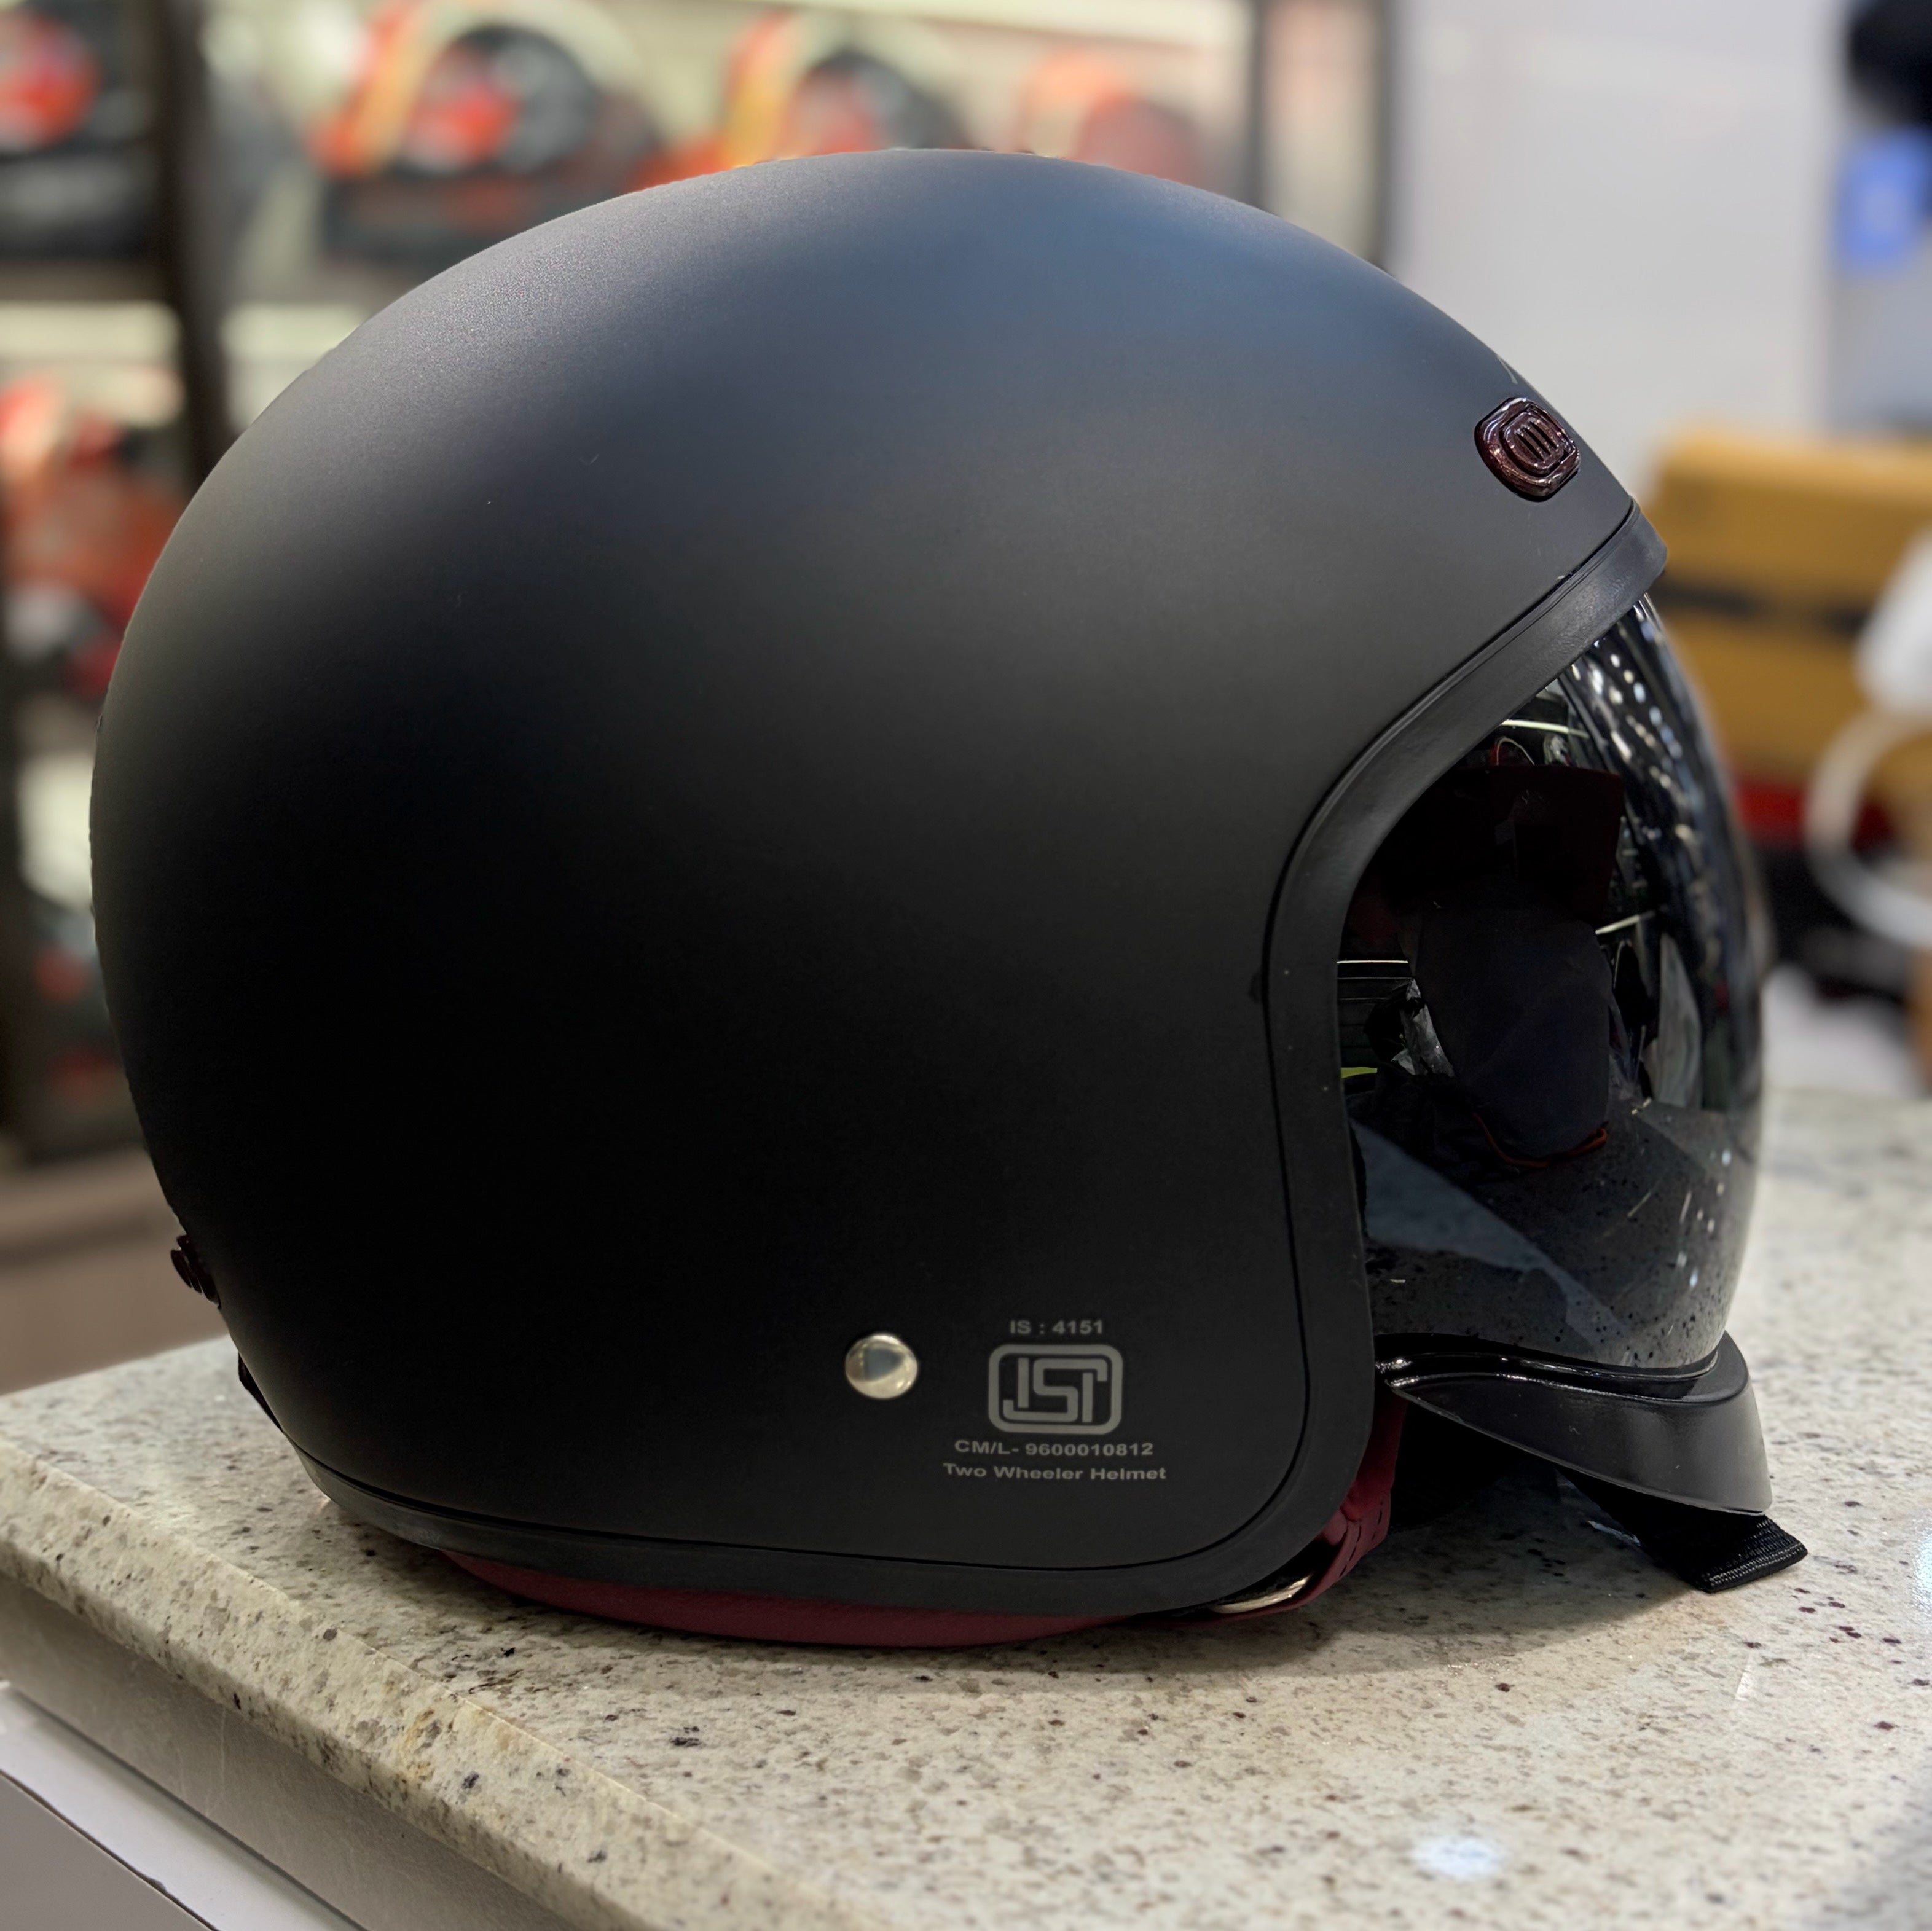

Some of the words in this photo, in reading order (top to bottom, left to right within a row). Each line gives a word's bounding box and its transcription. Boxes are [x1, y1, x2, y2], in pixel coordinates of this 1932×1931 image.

[1010, 1320, 1031, 1334] IS
[1052, 1320, 1104, 1335] 4151
[954, 1439, 1019, 1455] CM/L-
[1025, 1442, 1154, 1457] 9600010812
[942, 1462, 987, 1477] Two
[993, 1465, 1083, 1480] Wheeler
[1091, 1467, 1167, 1481] Helmet
